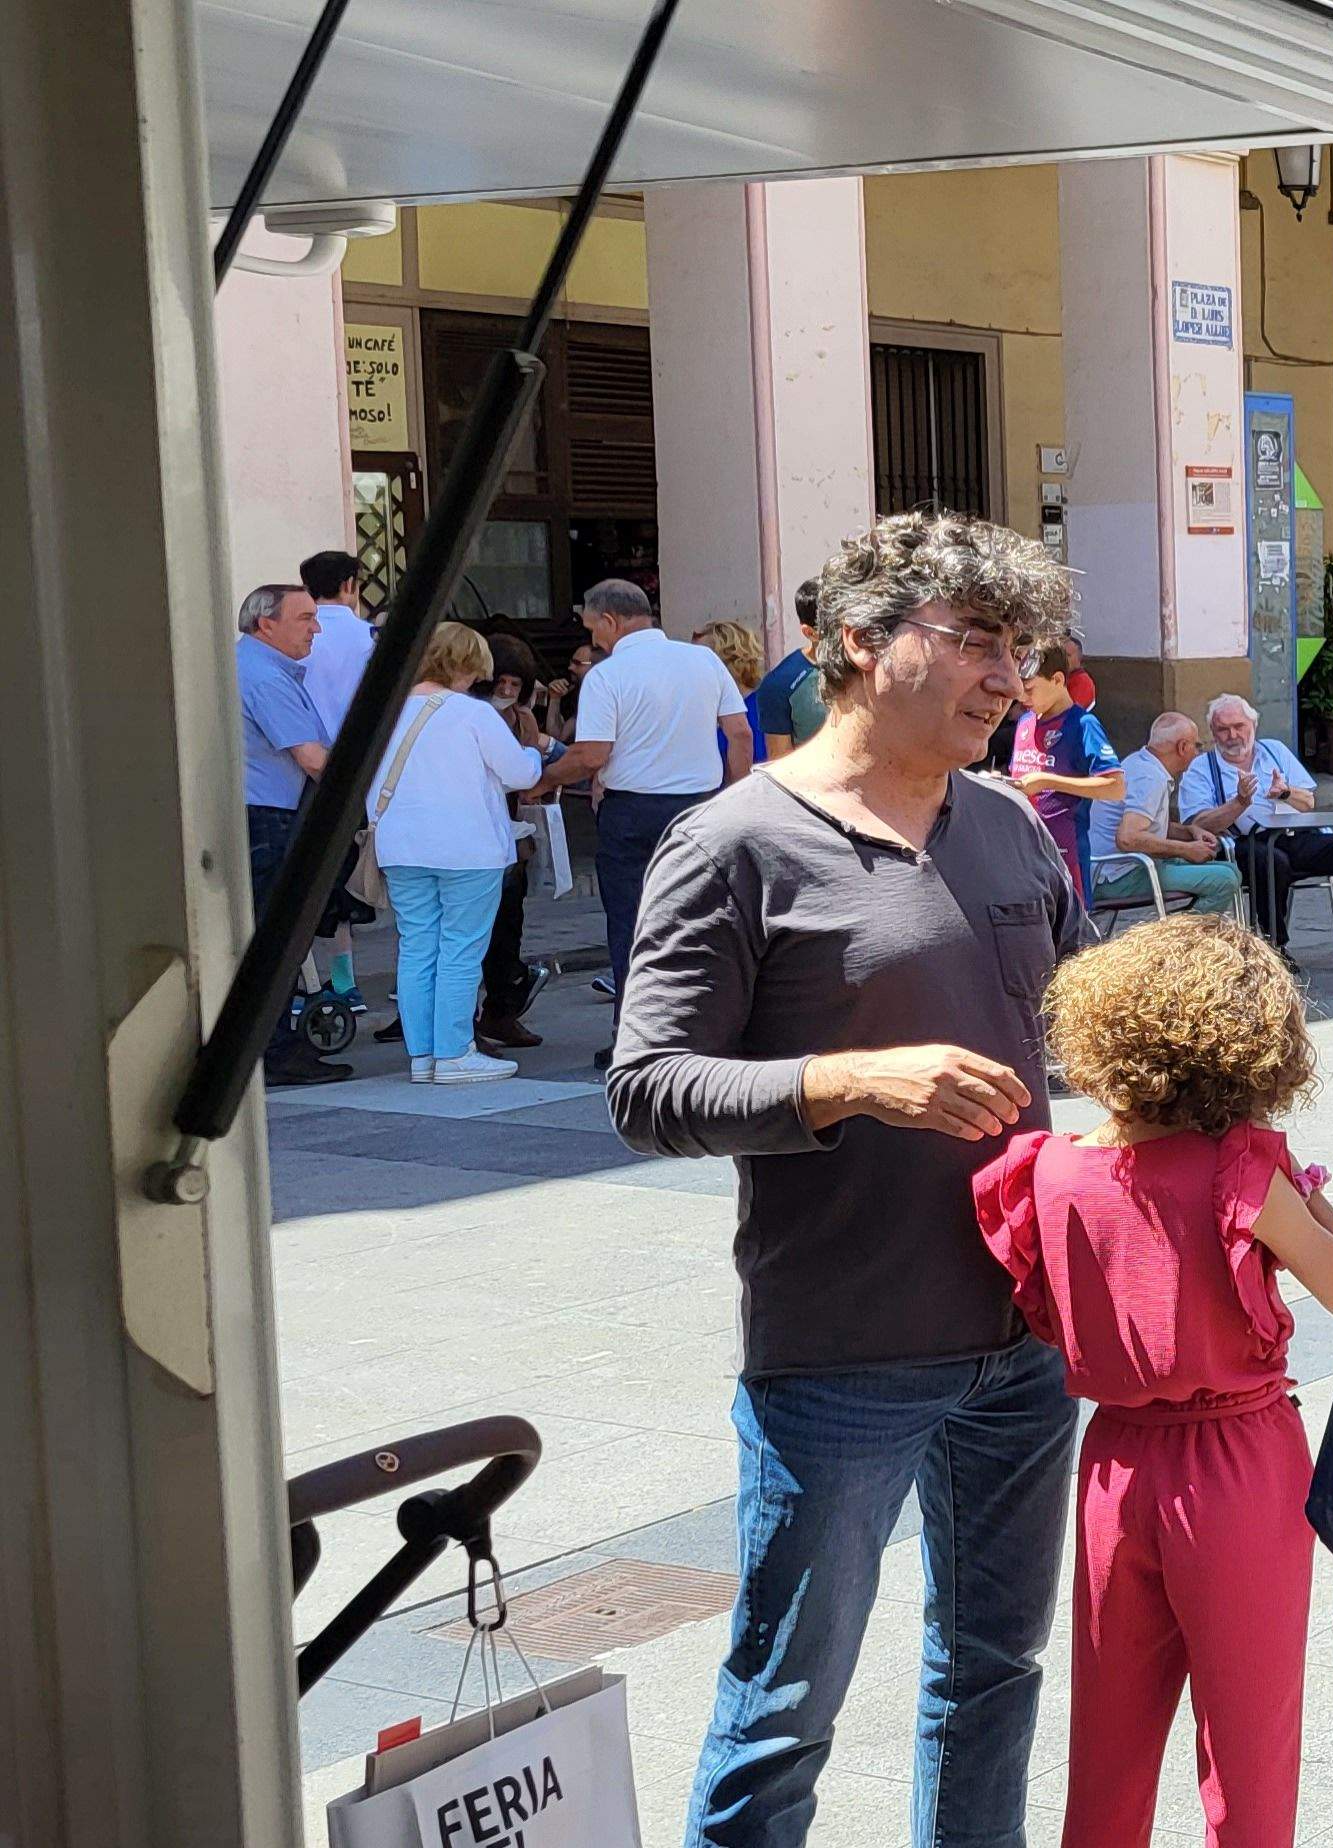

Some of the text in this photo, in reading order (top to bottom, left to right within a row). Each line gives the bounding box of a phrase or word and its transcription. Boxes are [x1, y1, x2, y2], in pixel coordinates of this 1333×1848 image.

[1190, 292, 1227, 307] PLAZA DE
[1201, 308, 1225, 322] LUIS
[347, 333, 396, 352] UN CAFÉ
[366, 360, 399, 376] SOLO
[1013, 749, 1056, 768] uesca
[437, 1756, 564, 1848] FERIA
